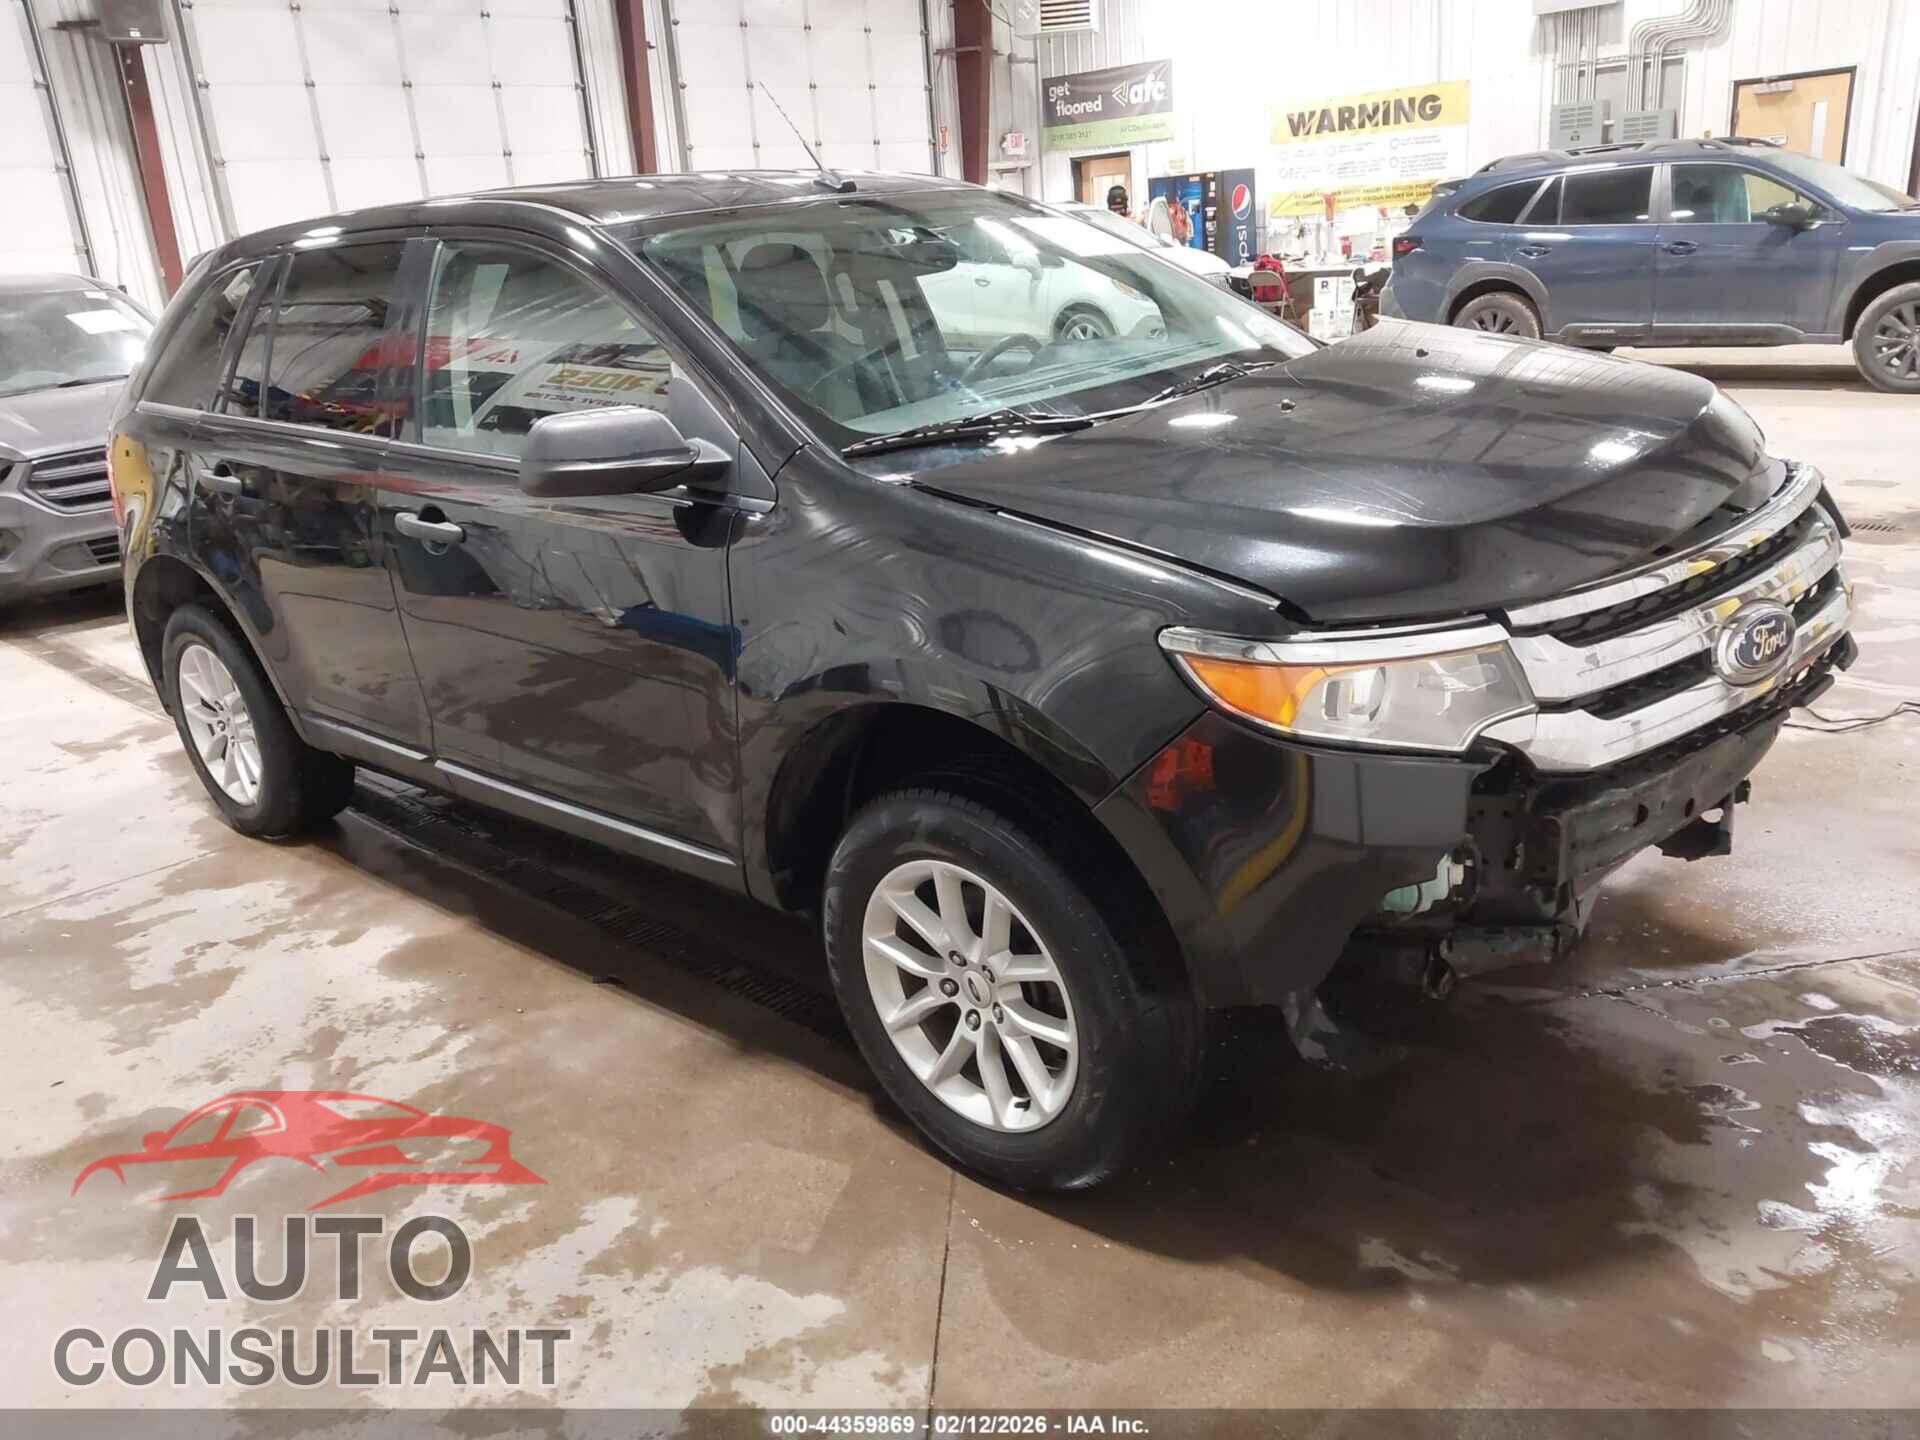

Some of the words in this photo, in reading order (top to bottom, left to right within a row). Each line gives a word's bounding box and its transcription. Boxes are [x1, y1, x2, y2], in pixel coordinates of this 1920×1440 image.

[1049, 82, 1071, 102] get
[1056, 95, 1102, 116] floored
[1129, 72, 1166, 105] afc
[1287, 94, 1442, 137] WARNING
[1236, 225, 1250, 266] epsi
[1753, 619, 1787, 661] Ford
